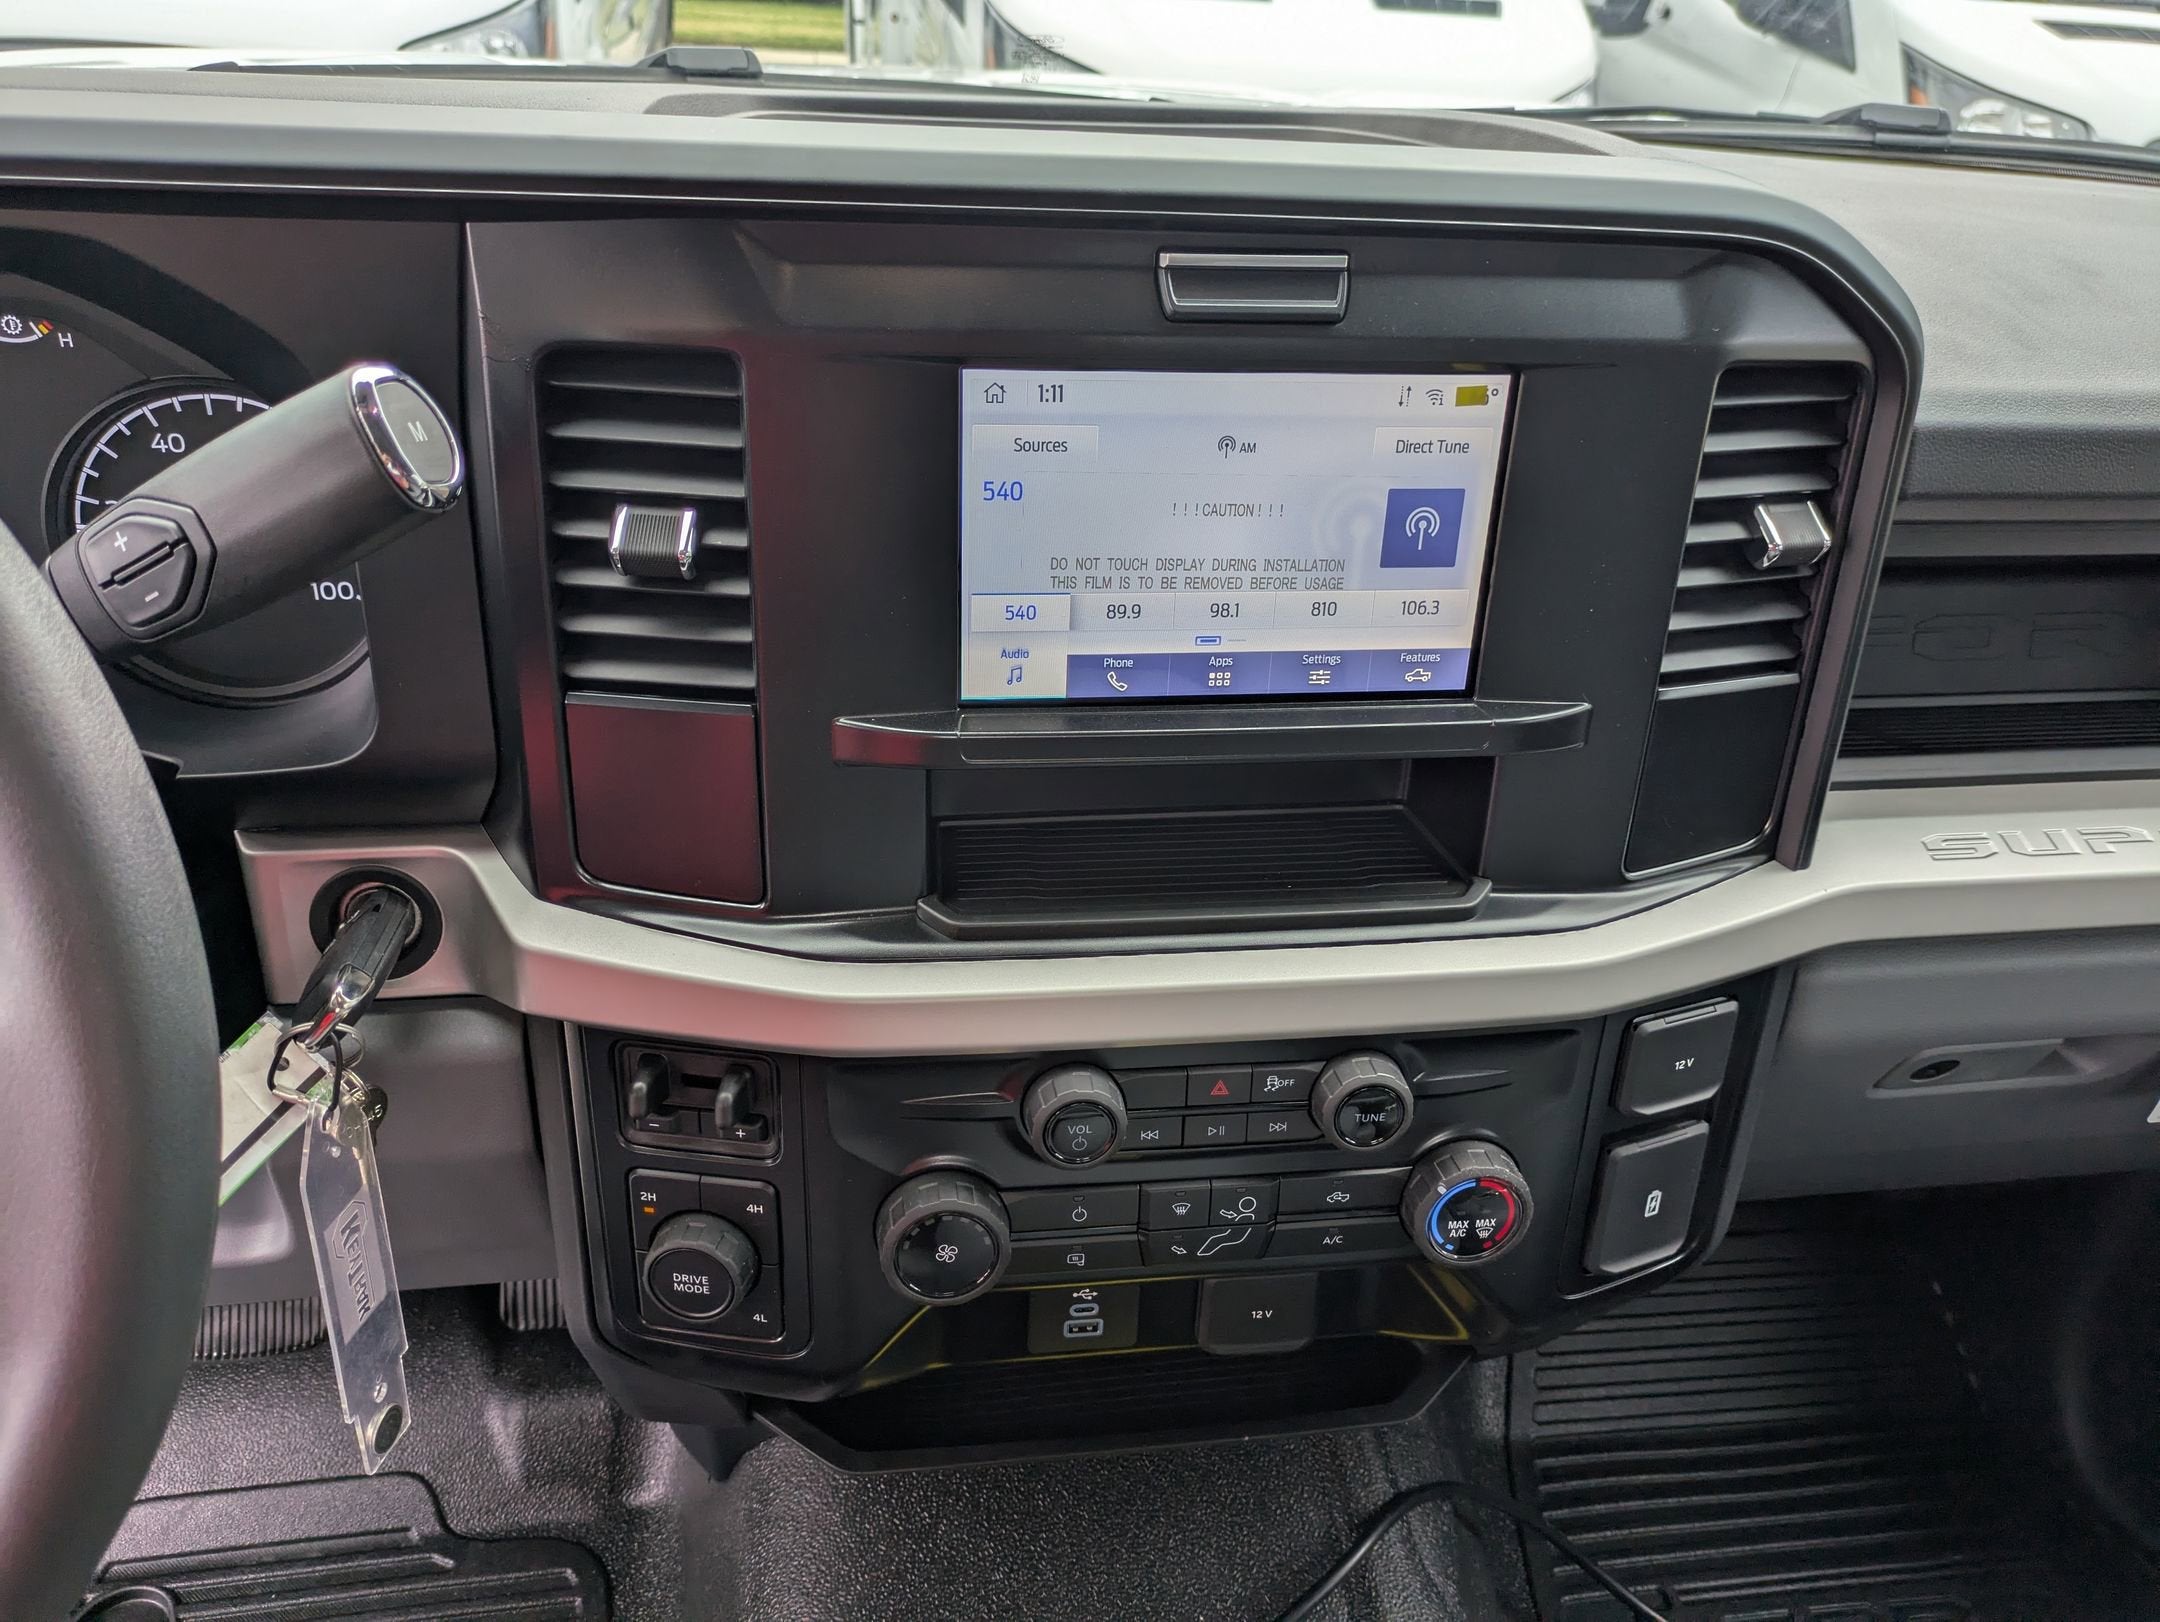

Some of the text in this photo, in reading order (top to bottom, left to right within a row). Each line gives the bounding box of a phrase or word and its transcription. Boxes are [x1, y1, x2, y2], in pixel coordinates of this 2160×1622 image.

[58, 332, 74, 348] H
[1038, 384, 1064, 403] 1:11
[407, 421, 429, 442] M
[151, 433, 186, 453] 40
[1013, 437, 1068, 453] Sources
[1239, 442, 1257, 454] AM
[1395, 439, 1470, 454] Direct Tune
[983, 481, 1023, 501] 540
[1050, 557, 1345, 573] DO NOT TOUCH DISPLAY DURING INSTALLATION
[1050, 576, 1345, 591] THIS FILM IS TO BE REMOVED BEFORE USAGE
[310, 581, 354, 601] 100
[1005, 605, 1037, 621] 540
[1106, 604, 1142, 620] 89.9
[1209, 603, 1240, 618] 98.1
[1311, 601, 1338, 617] 810
[1401, 600, 1440, 616] 106.3
[1000, 648, 1030, 660] Audio
[1302, 654, 1341, 666] Settings
[1400, 652, 1441, 664] Features
[1103, 658, 1134, 669] Phone
[1208, 656, 1234, 668] Apps
[1921, 826, 2160, 861] SUP
[1277, 1078, 1296, 1087] OFF
[1354, 1112, 1387, 1123] TUNE
[1067, 1124, 1093, 1135] VOL
[640, 1191, 657, 1202] 2H
[746, 1203, 763, 1214] 4H
[1447, 1220, 1470, 1230] MAX
[1475, 1218, 1497, 1228] MAX
[1449, 1228, 1467, 1238] A/C
[1322, 1235, 1343, 1245] A/C
[672, 1272, 709, 1285] DRIVE
[673, 1283, 710, 1295] MODE
[753, 1313, 768, 1323] 4L
